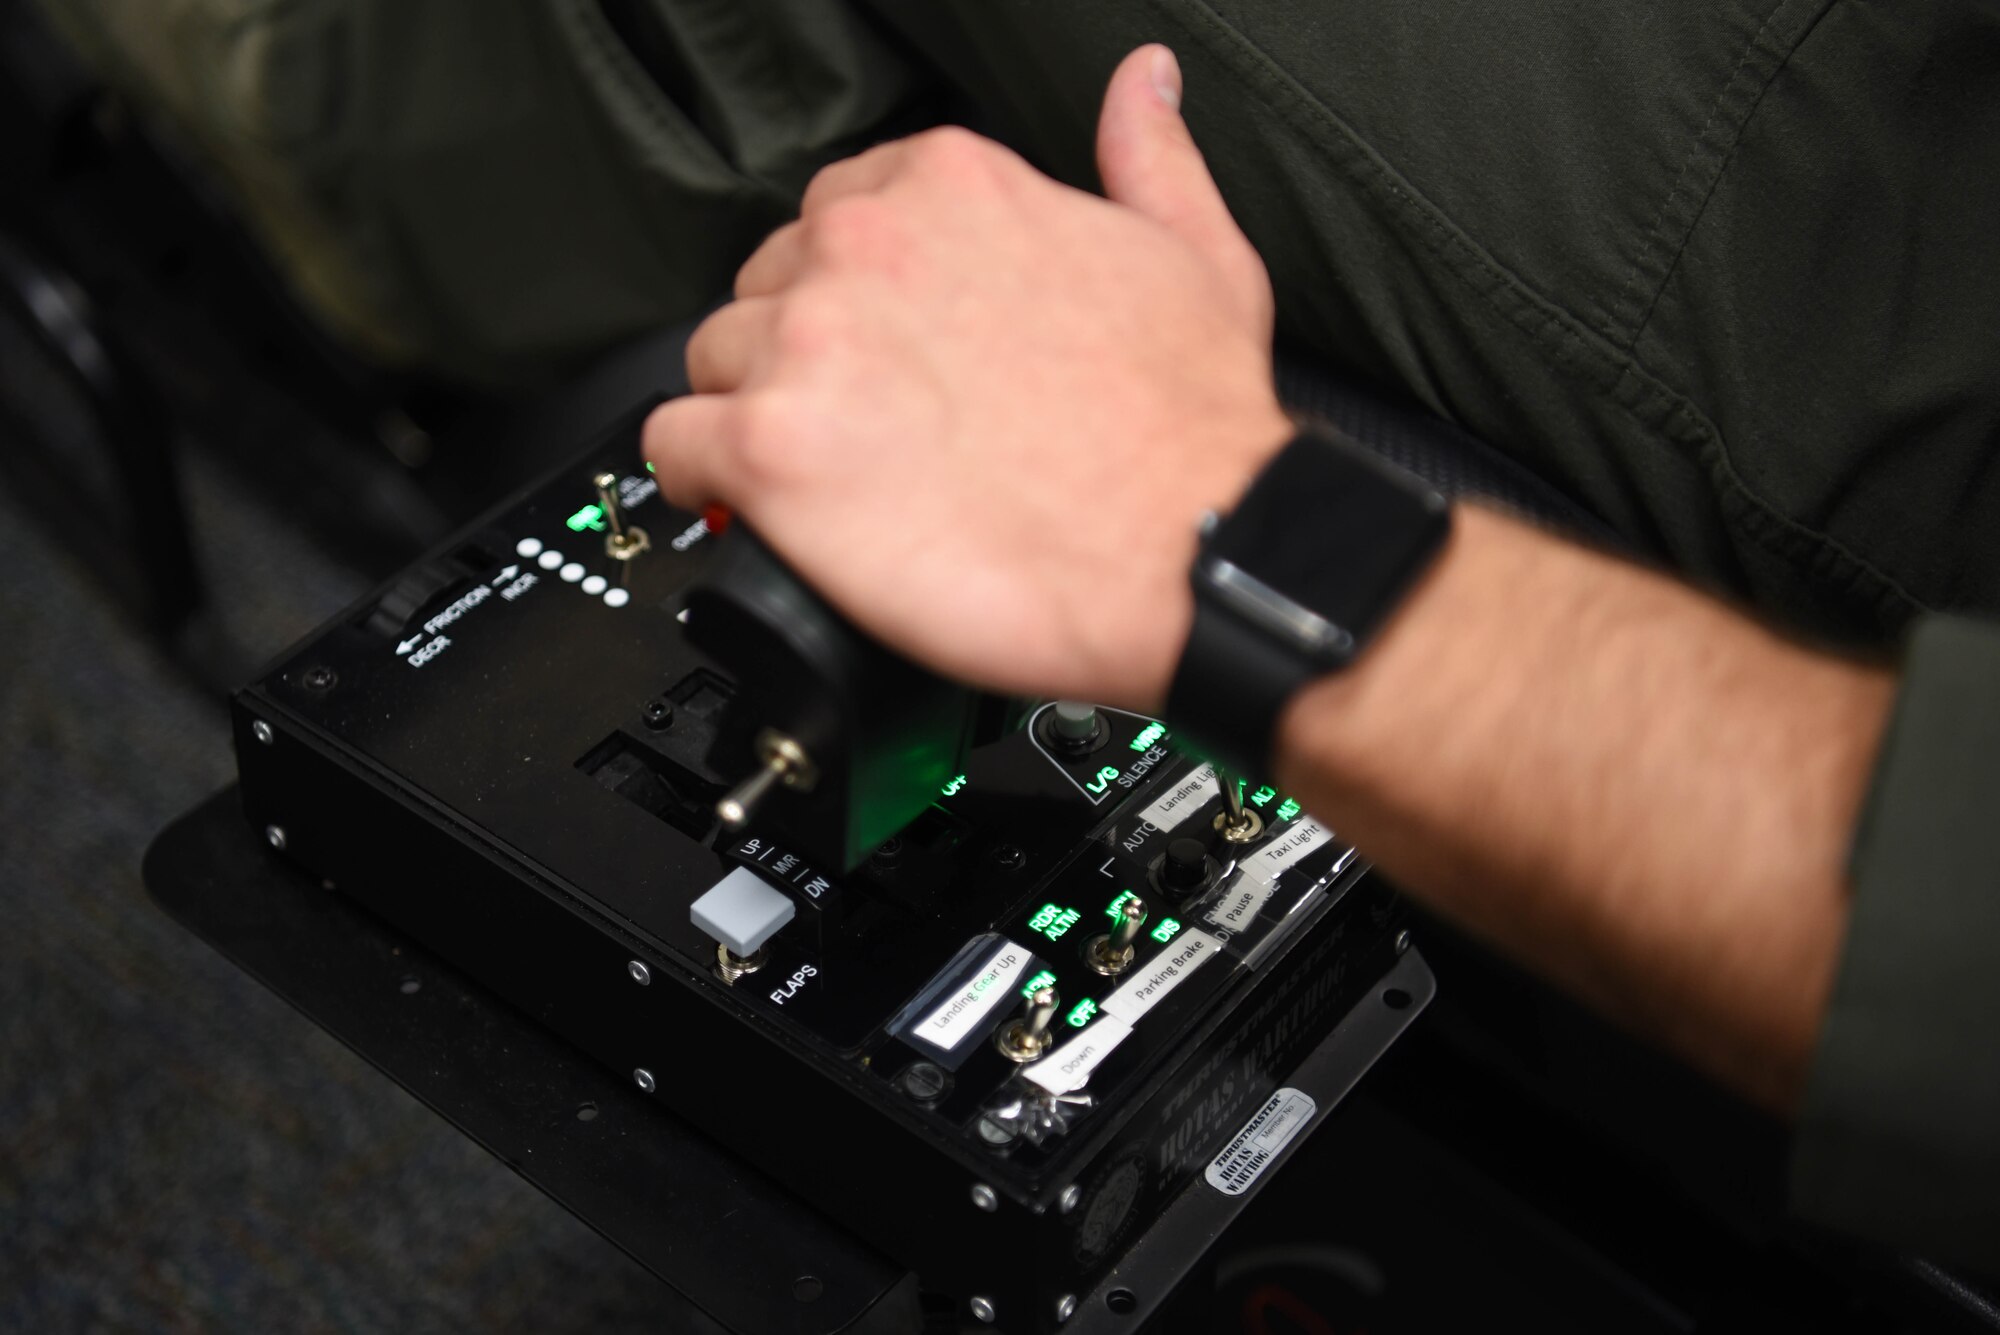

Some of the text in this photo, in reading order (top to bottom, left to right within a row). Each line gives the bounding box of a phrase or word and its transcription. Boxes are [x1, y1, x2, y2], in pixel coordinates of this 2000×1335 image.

[423, 584, 492, 635] FRICTION
[407, 634, 452, 668] DECR
[1086, 766, 1119, 793] L/G
[1117, 745, 1167, 787] SILENCE
[1159, 780, 1203, 812] Landing
[740, 838, 761, 855] UP
[1265, 823, 1320, 861] Taxi Light
[772, 854, 800, 875] MVR
[804, 876, 830, 898] DN
[1028, 903, 1062, 932] RDR
[1226, 892, 1254, 922] Pause
[1044, 907, 1081, 942] ALTM
[1151, 918, 1181, 943] DIS
[769, 964, 818, 1005] FLAPS
[1135, 940, 1204, 1000] Parking Brake
[933, 954, 1017, 1029] Landing Gear Up
[1067, 997, 1097, 1028] OFF
[1060, 1044, 1096, 1075] Down
[1214, 1097, 1281, 1168] THRUSTMASTER
[1261, 1112, 1284, 1139] Member
[1219, 1147, 1254, 1181] HOTAS
[1226, 1150, 1269, 1193] WARTHOG
